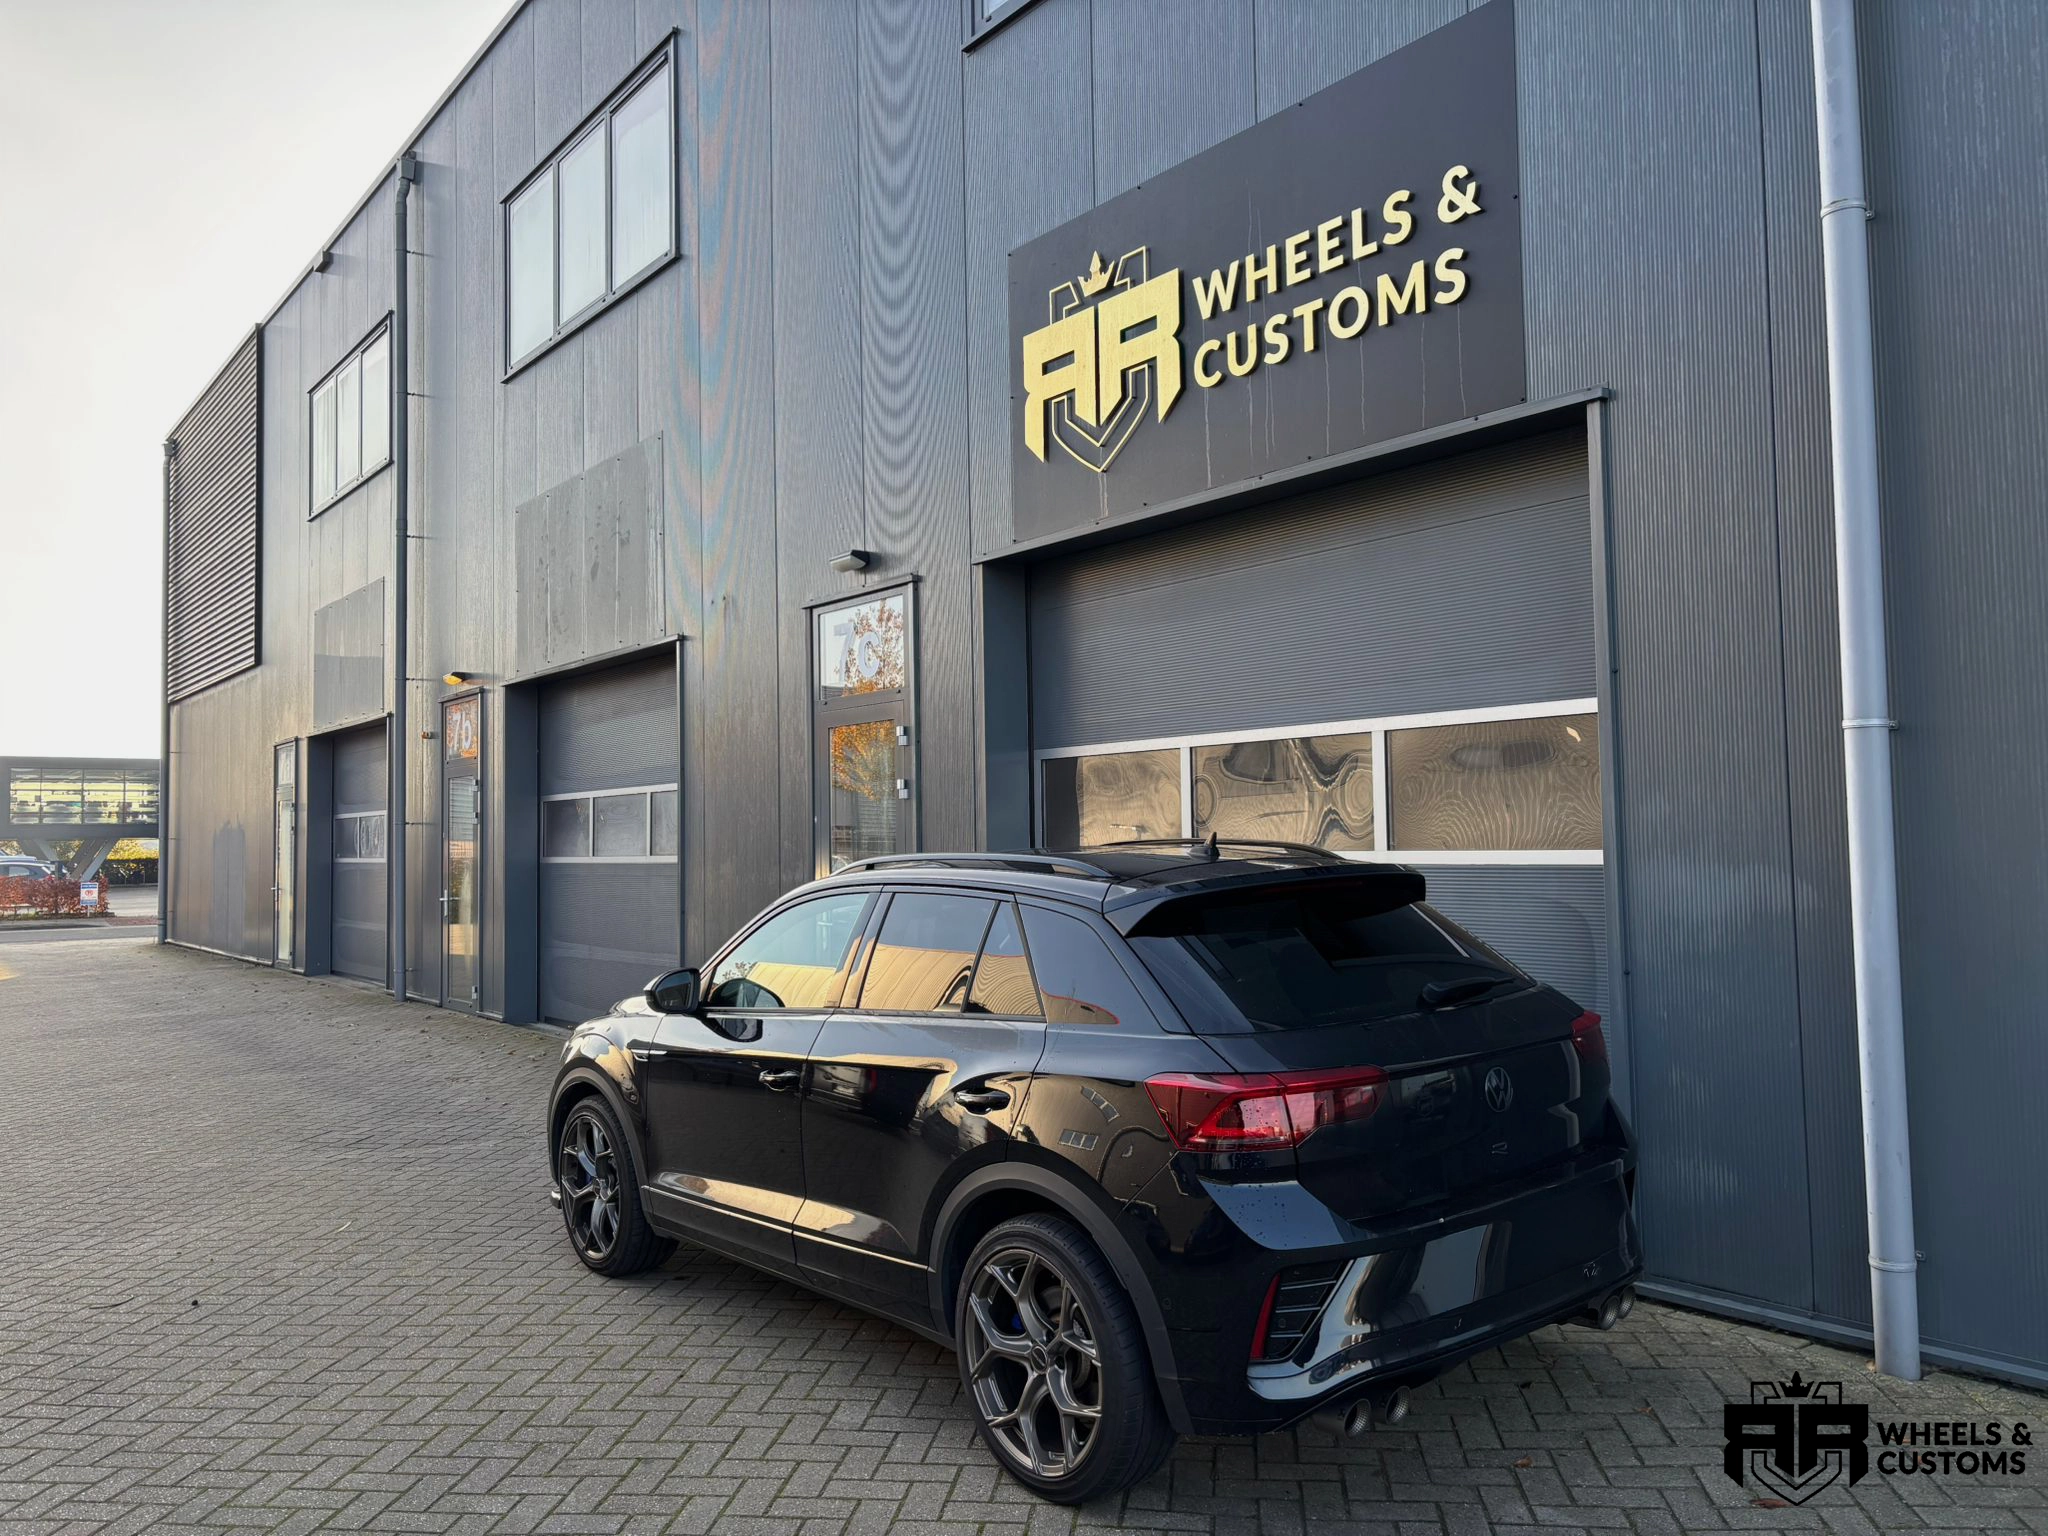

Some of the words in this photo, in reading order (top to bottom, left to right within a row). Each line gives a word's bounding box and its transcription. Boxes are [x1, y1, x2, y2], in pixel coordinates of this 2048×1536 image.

[1192, 190, 1413, 320] WHEELS
[1437, 165, 1482, 223] &
[1194, 248, 1467, 389] CUSTOMS
